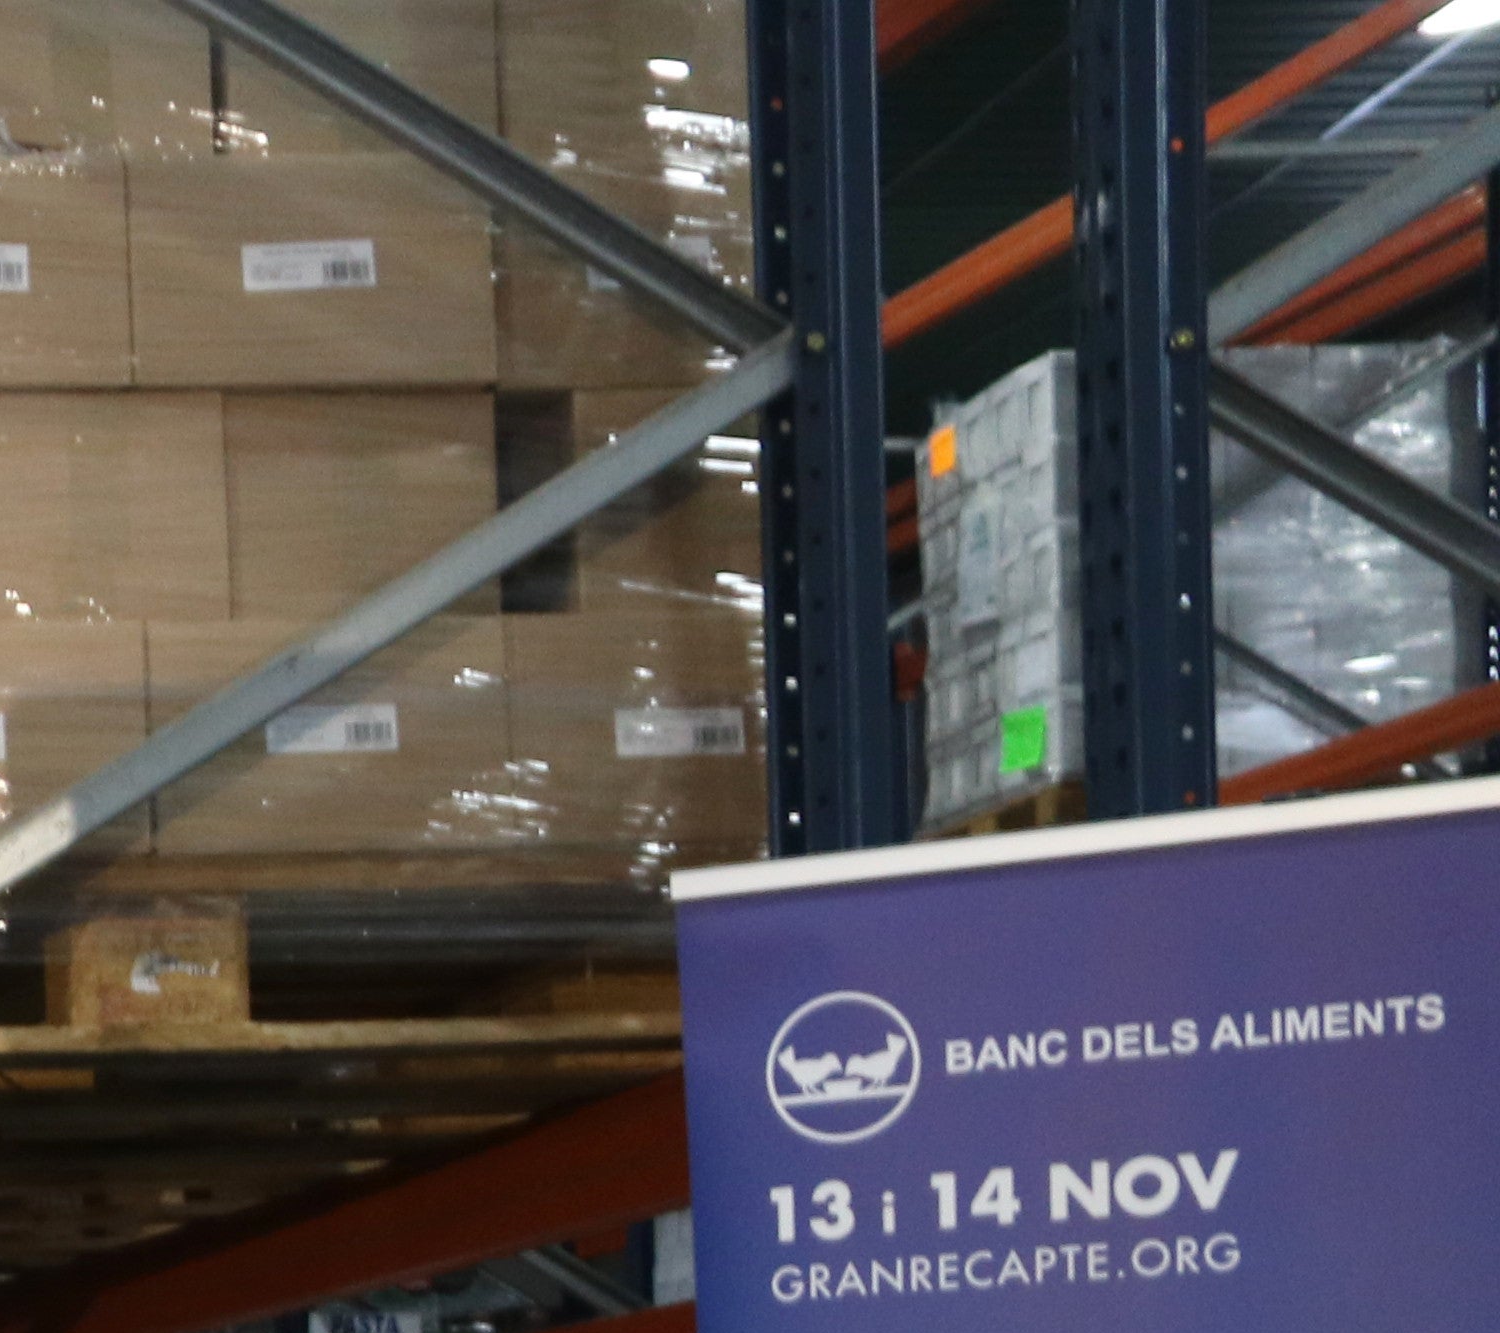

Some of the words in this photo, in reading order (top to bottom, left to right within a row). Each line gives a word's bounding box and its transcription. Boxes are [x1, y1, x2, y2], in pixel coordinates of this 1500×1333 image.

[945, 1030, 1068, 1076] BANC
[1083, 1018, 1200, 1063] DELS
[1210, 993, 1445, 1051] ALIMENTS
[769, 1180, 855, 1243] 13
[881, 1189, 898, 1235] i
[931, 1166, 1022, 1231] 14
[1049, 1149, 1239, 1222] NOV
[770, 1232, 1242, 1303] GRANRECAPTE.ORG
